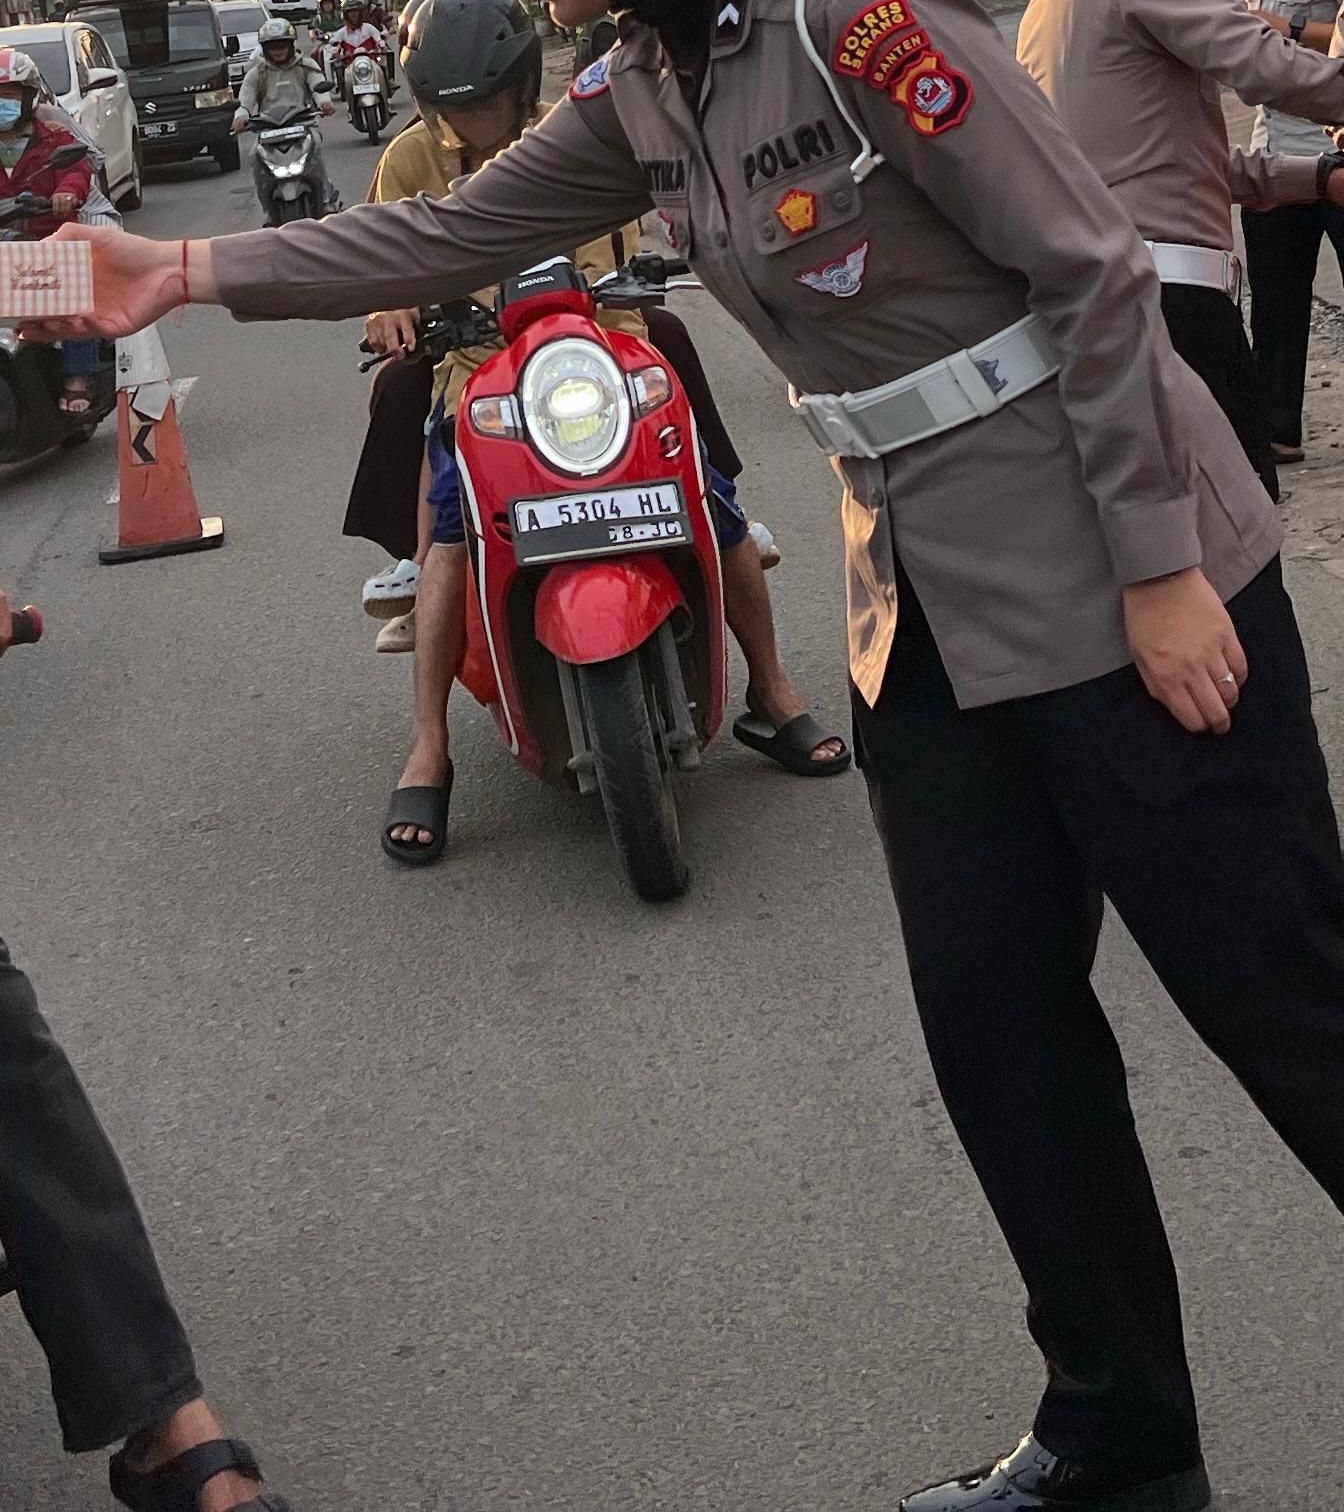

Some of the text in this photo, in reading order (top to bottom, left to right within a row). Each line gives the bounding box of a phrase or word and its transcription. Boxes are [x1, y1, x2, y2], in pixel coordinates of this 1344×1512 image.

[839, 1, 902, 66] POLRES
[851, 13, 905, 70] SERANG
[873, 34, 921, 83] BANTEN
[438, 84, 474, 96] HONDA
[743, 119, 836, 189] POLRI
[517, 275, 555, 289] HONDA
[526, 491, 673, 532] A 5304 HL
